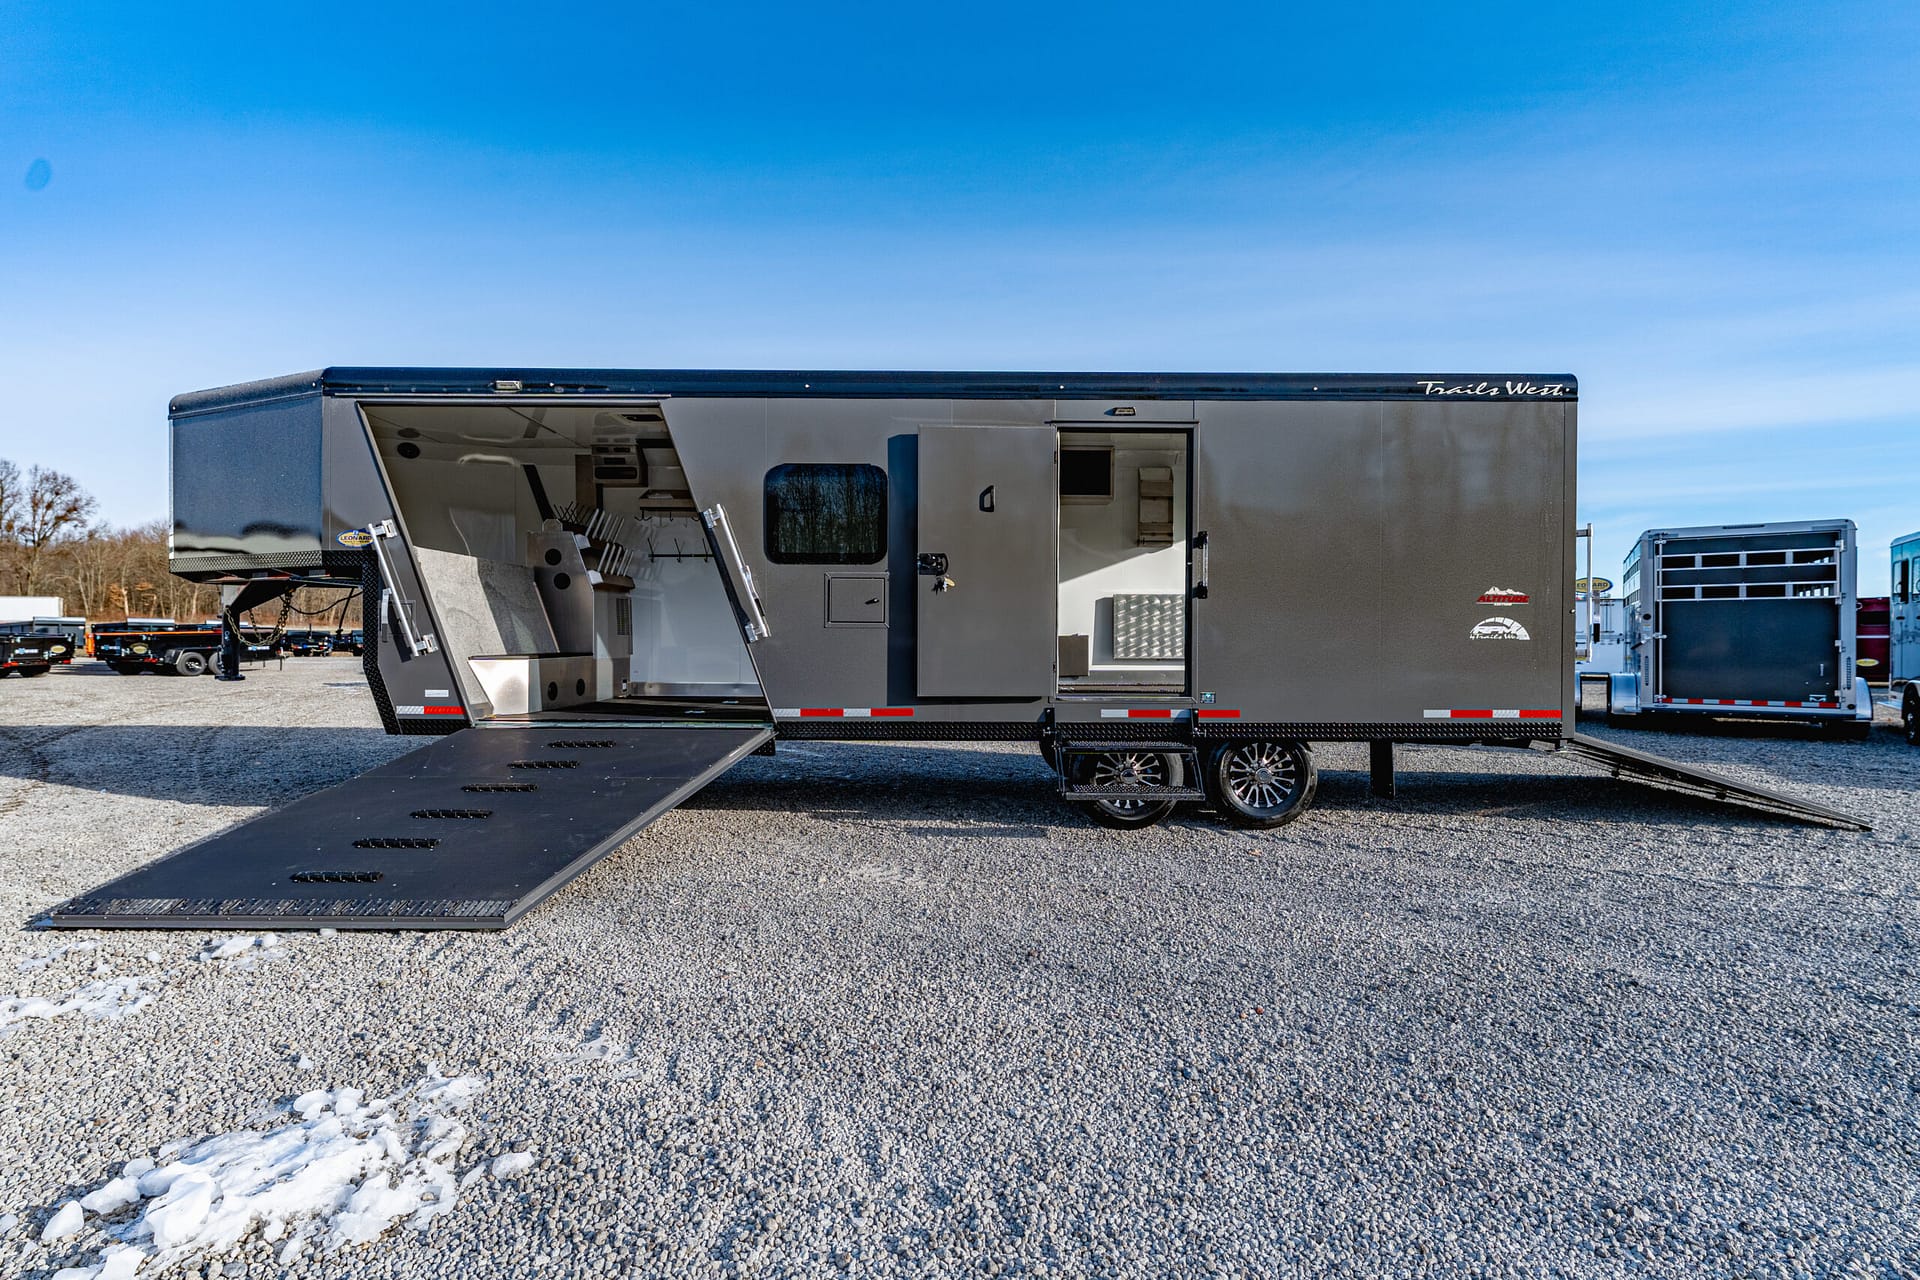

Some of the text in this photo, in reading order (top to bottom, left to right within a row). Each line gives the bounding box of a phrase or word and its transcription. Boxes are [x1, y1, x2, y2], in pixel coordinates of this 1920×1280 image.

[1417, 381, 1563, 396] Trails West
[1476, 595, 1530, 603] ALTITUDE
